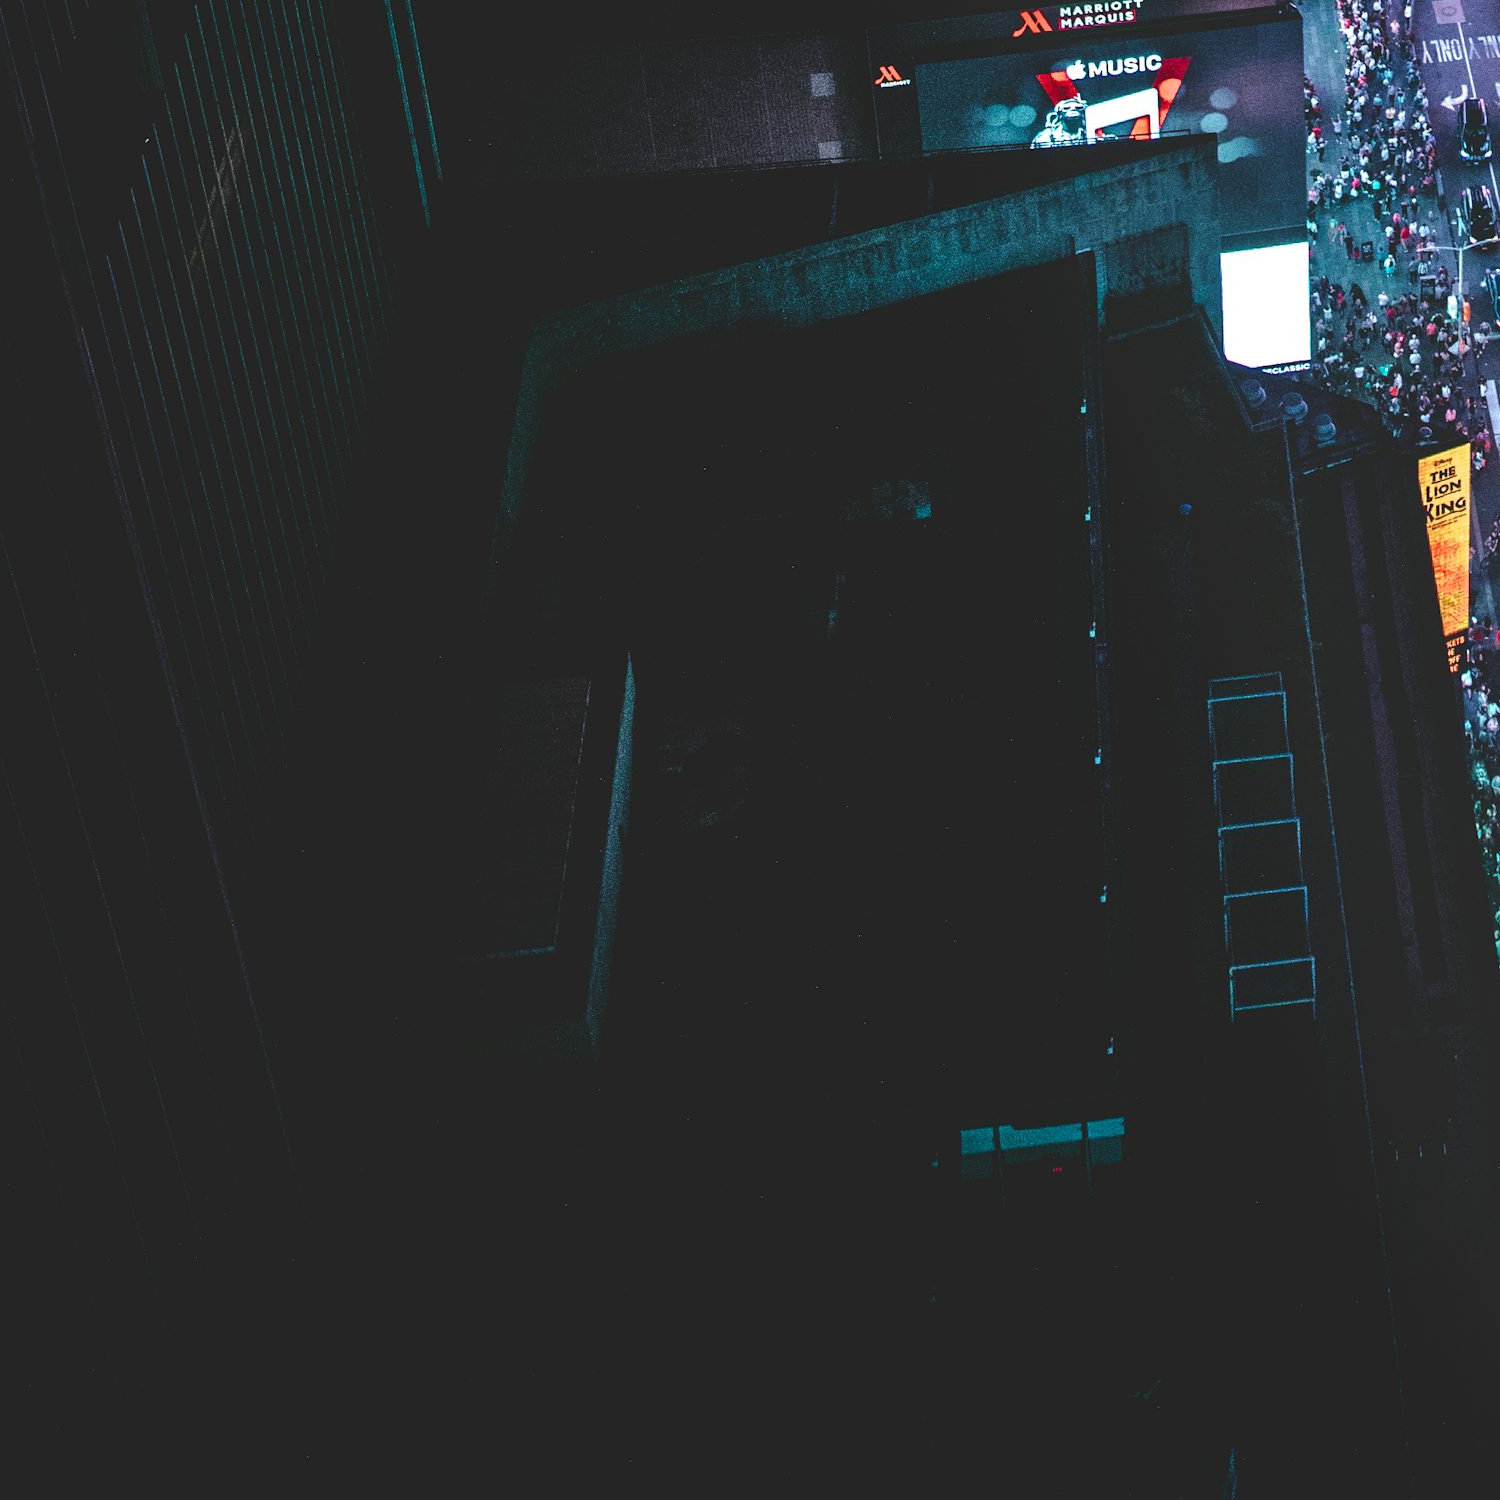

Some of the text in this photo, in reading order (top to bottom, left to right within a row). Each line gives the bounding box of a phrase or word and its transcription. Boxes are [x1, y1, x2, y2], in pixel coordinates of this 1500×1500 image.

[1060, 11, 1135, 30] MARQUIS
[1422, 39, 1462, 64] ONLY
[1088, 54, 1163, 78] MUSIC
[1430, 466, 1457, 483] THE
[1426, 479, 1462, 503] LION
[1425, 496, 1466, 522] KING
